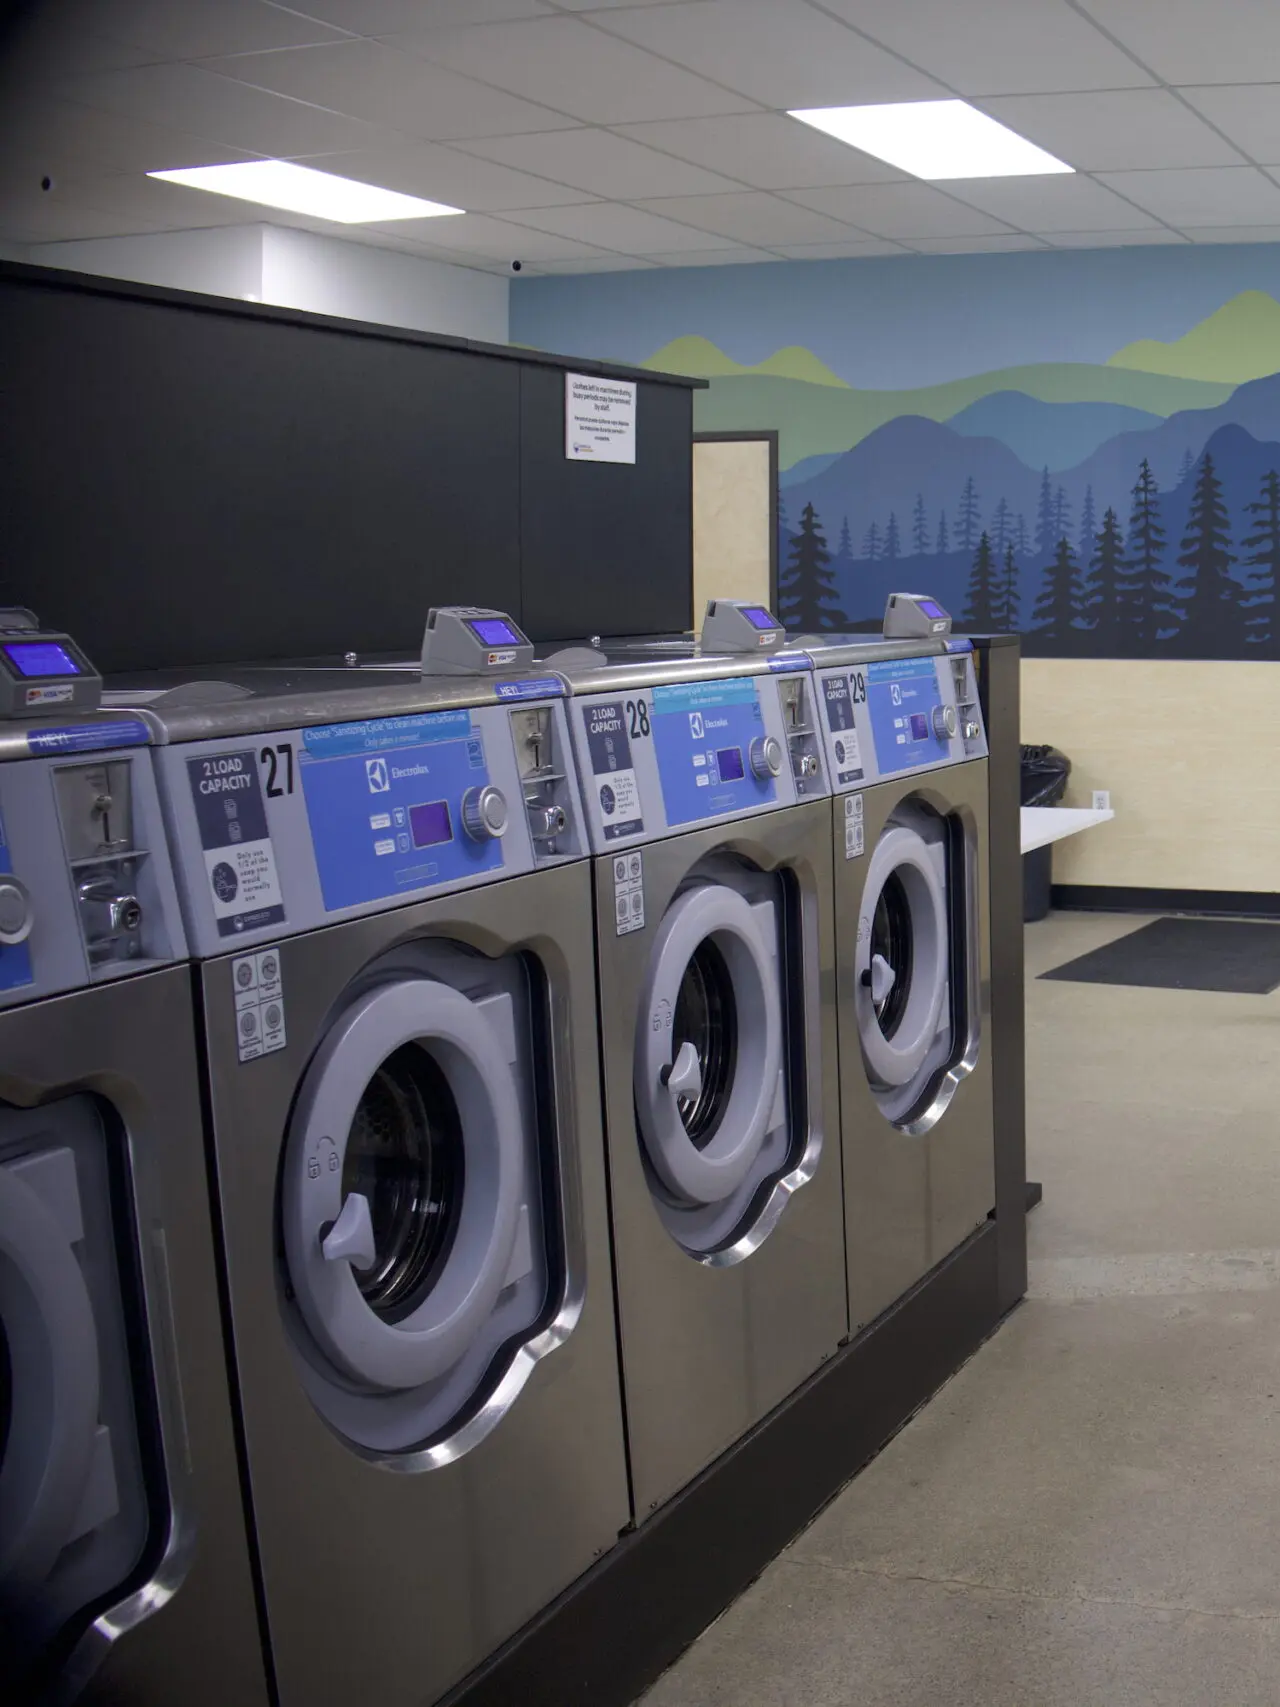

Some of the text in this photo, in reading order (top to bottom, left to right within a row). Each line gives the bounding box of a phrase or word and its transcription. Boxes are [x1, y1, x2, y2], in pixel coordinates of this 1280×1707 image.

[850, 672, 866, 704] 29
[591, 707, 616, 720] 2 LOAD
[626, 699, 650, 739] 28
[590, 720, 622, 734] CAPACITY
[203, 758, 242, 776] 2 LOAD
[260, 744, 294, 798] 27
[391, 764, 430, 779] Electrolux
[200, 774, 251, 795] CAPACITY
